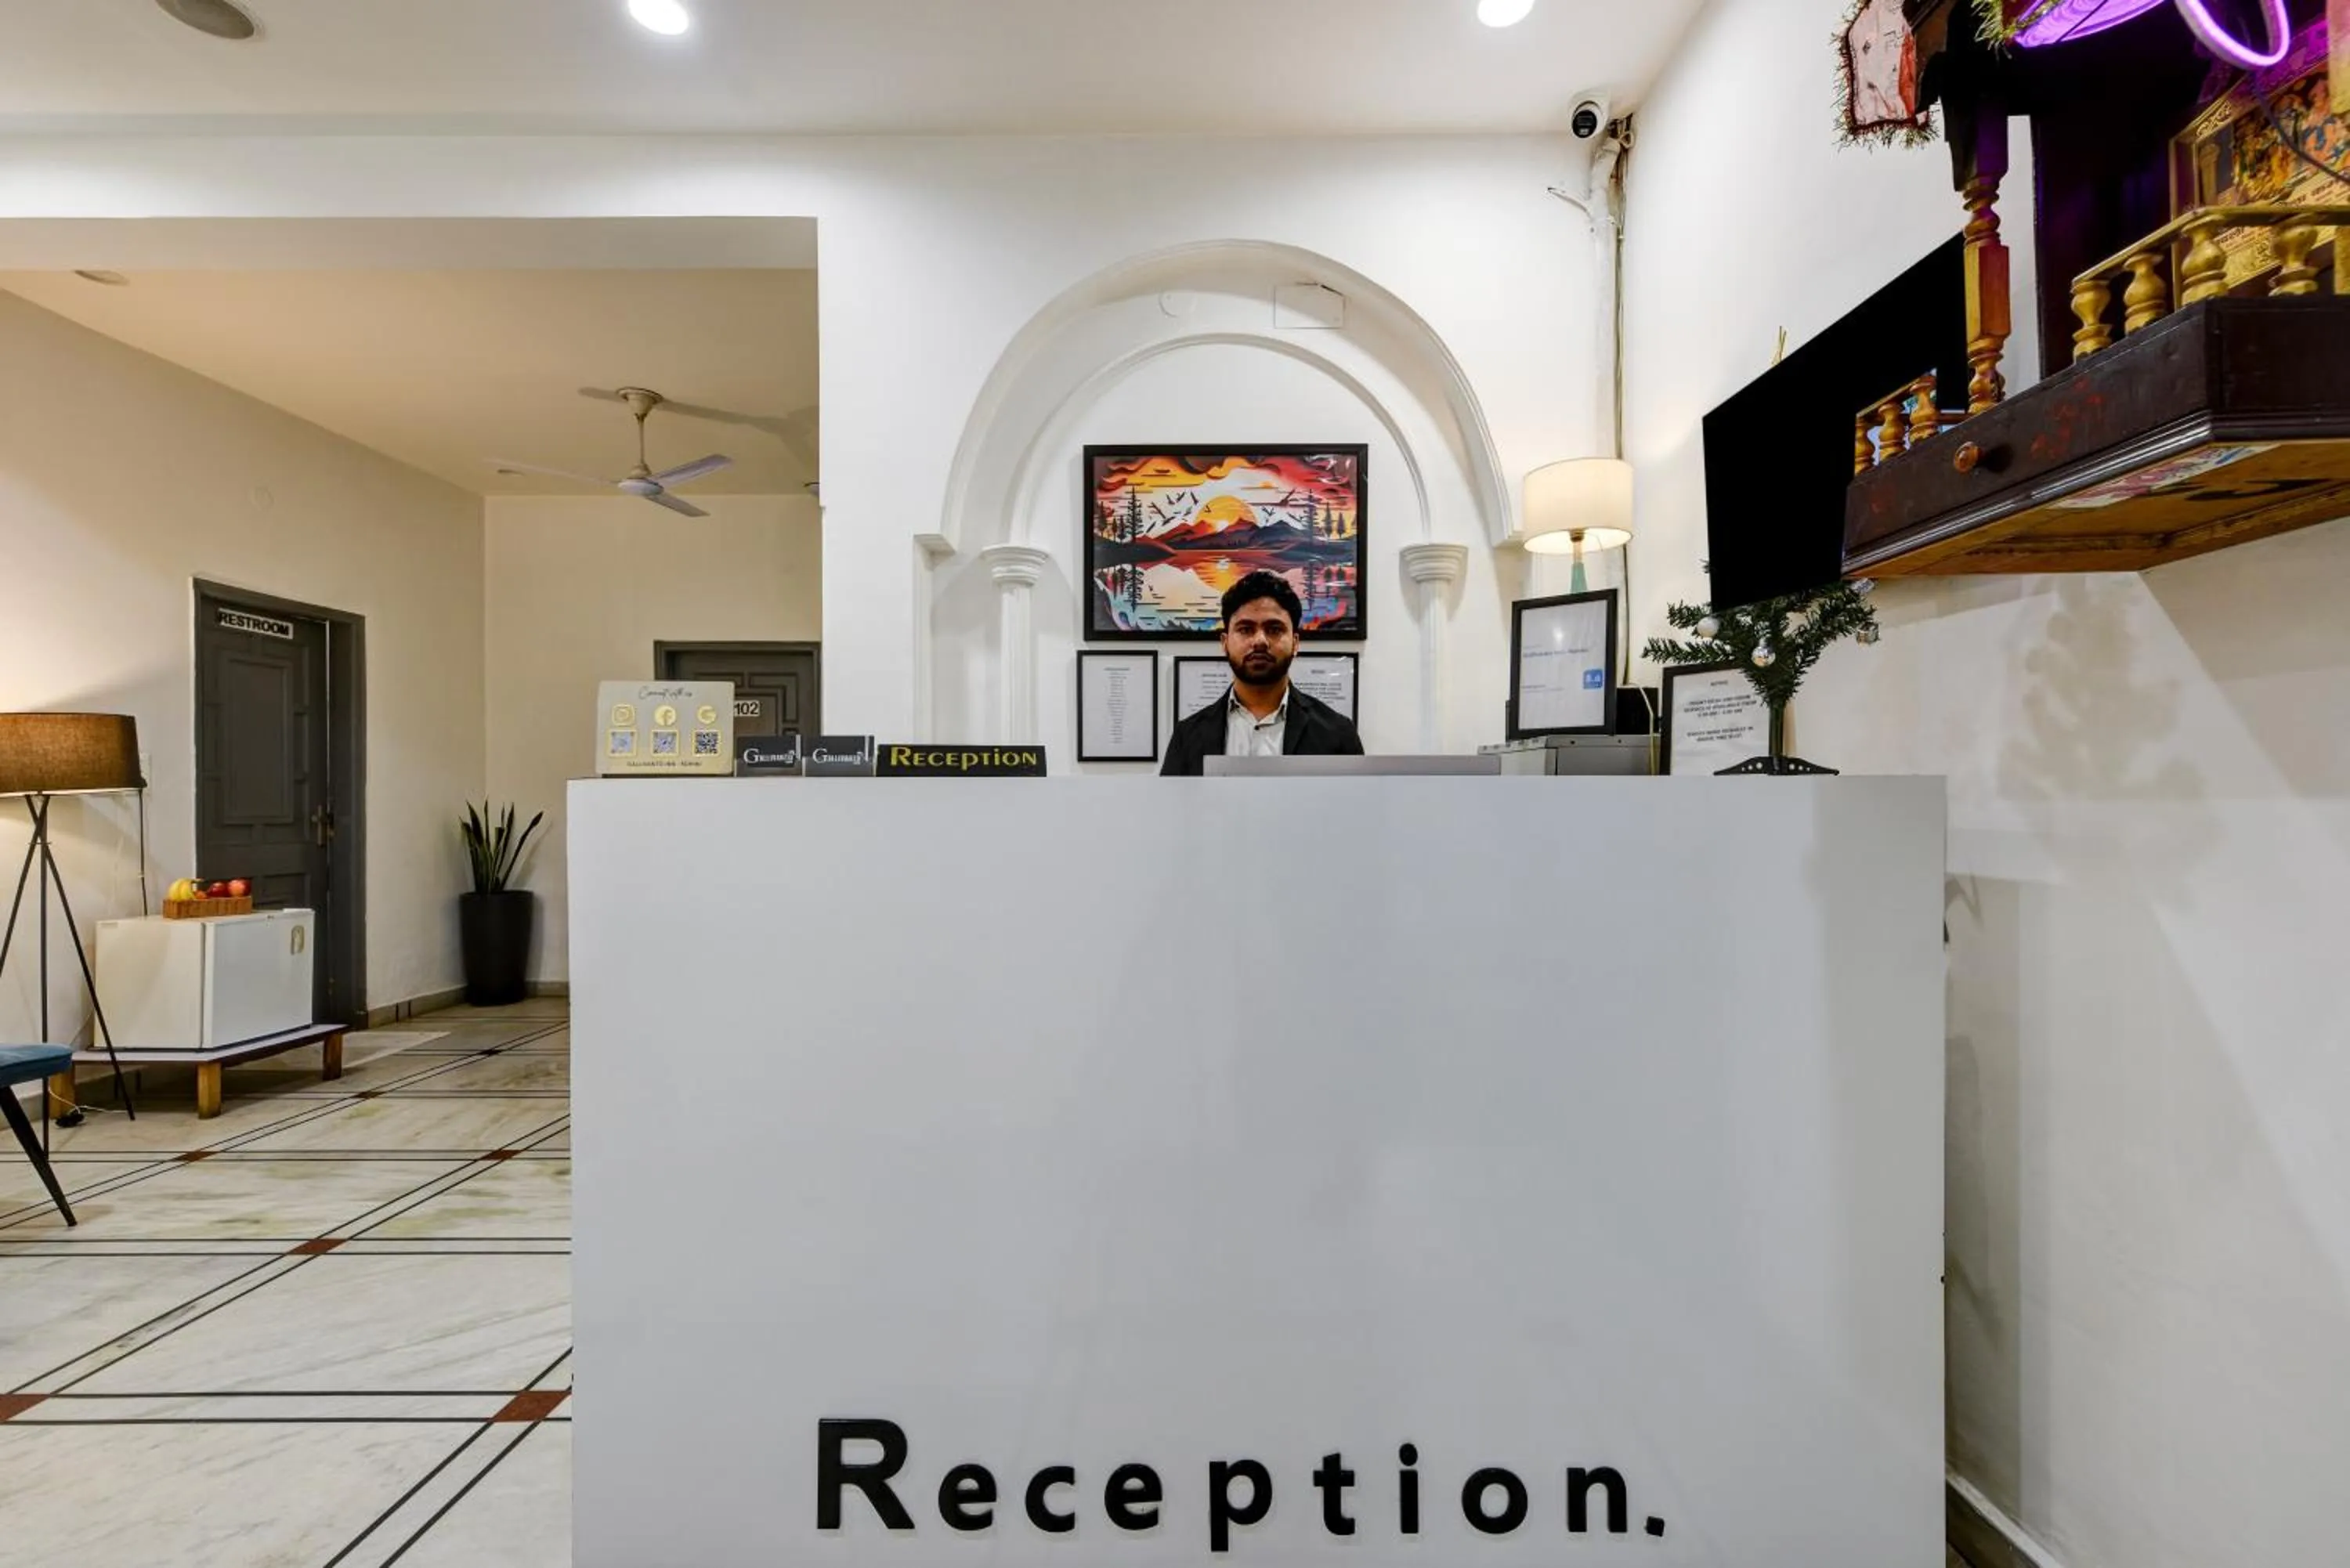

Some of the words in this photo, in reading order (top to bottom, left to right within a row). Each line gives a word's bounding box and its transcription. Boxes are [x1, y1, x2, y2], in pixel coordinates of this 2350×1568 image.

[219, 612, 289, 636] RESTROOM
[734, 701, 758, 715] 102
[817, 1418, 1665, 1552] Reception.
